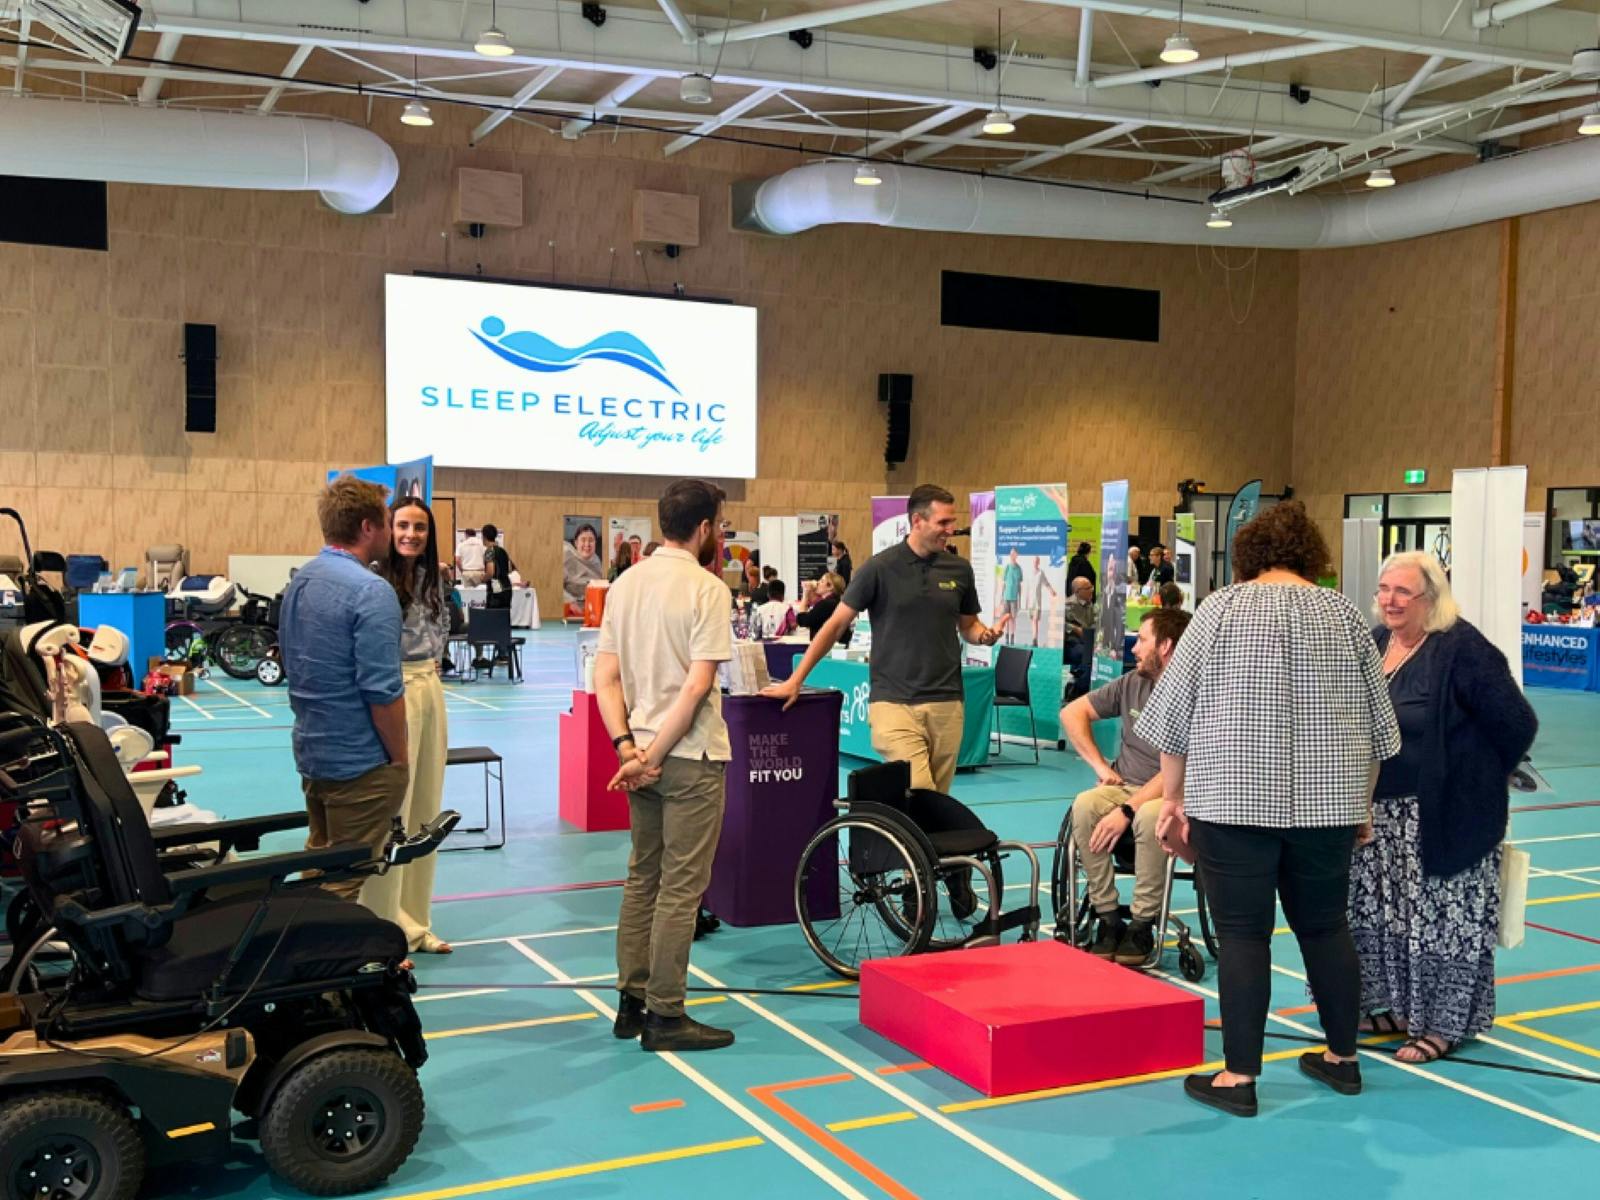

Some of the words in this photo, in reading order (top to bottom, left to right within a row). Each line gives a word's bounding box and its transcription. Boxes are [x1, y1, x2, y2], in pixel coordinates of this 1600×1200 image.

[421, 386, 540, 411] SLEEP
[554, 394, 726, 422] ELECTRIC
[578, 421, 647, 447] Adjust
[637, 432, 686, 449] your
[691, 427, 725, 452] life
[998, 525, 1021, 535] Support
[1022, 525, 1058, 533] Coordination
[1523, 645, 1588, 666] ifestyles
[748, 733, 789, 746] MAKE
[750, 745, 778, 758] THE
[750, 756, 802, 770] WORLD
[749, 769, 772, 783] FIT
[773, 767, 802, 782] YOU
